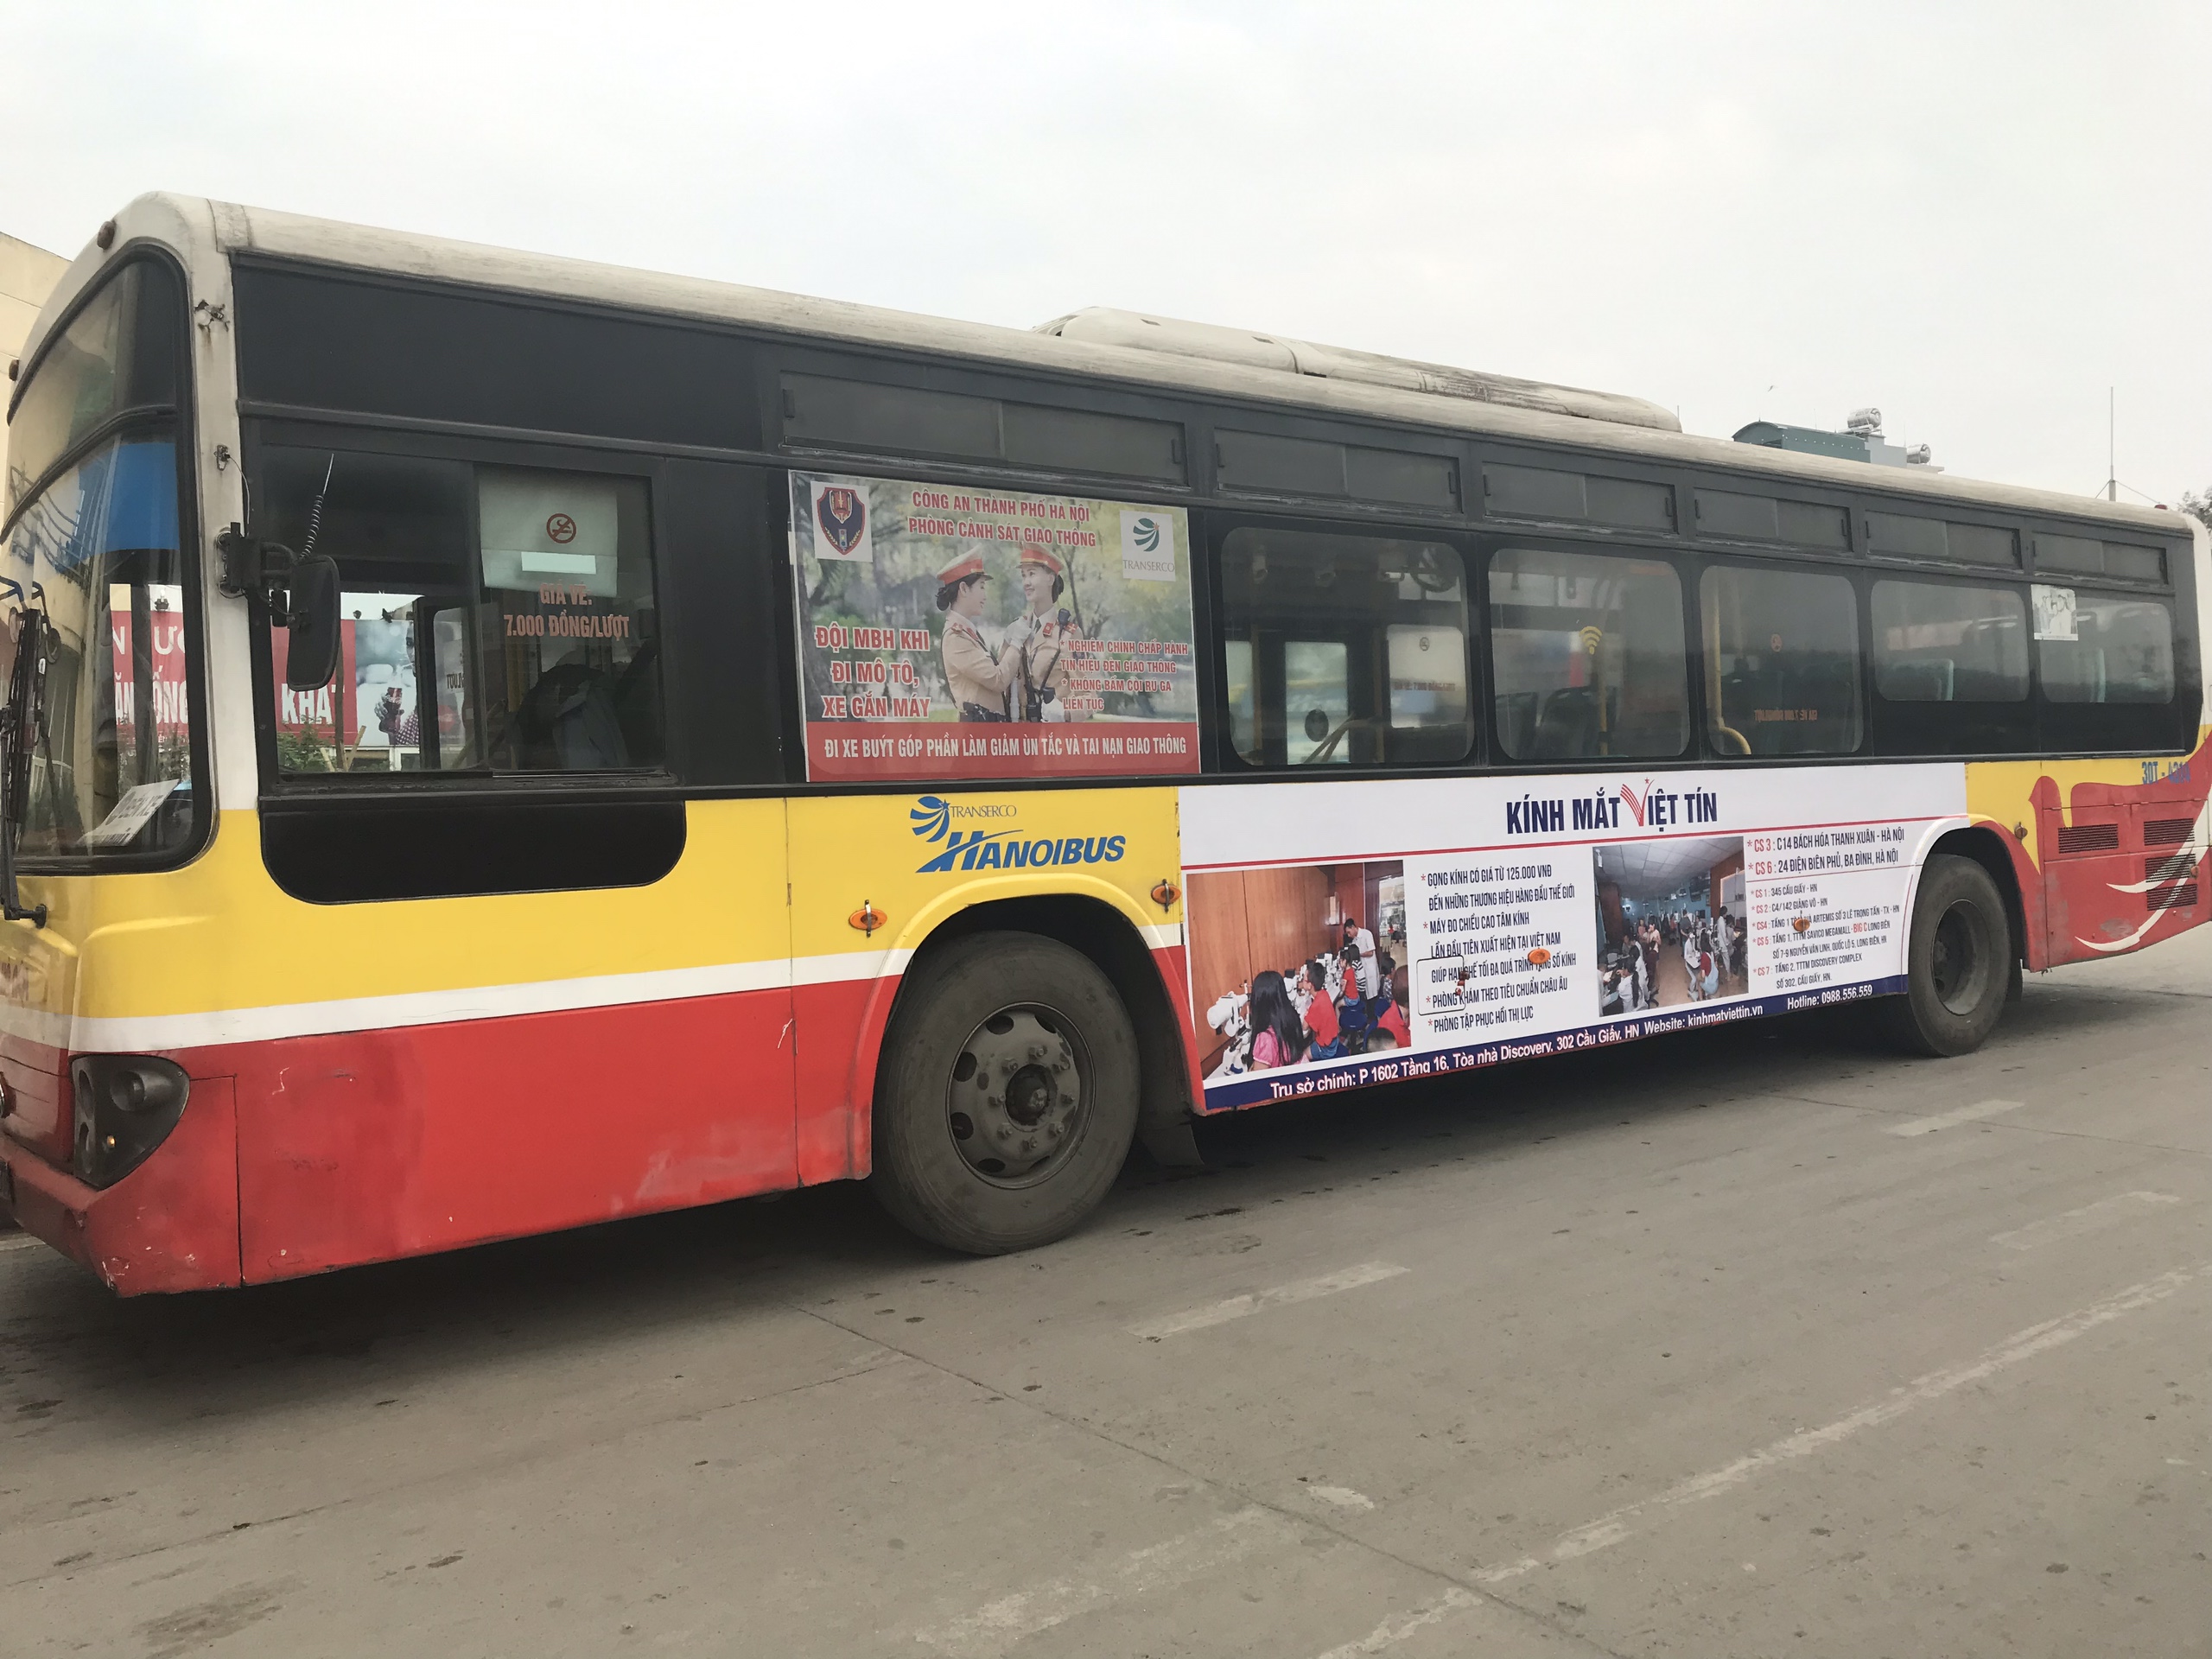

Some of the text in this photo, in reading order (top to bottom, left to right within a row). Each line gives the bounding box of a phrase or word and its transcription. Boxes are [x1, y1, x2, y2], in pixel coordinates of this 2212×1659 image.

[912, 490, 1090, 524] CÔNG AN THÀNH PHỐ HÀ NỘI
[909, 516, 1096, 547] PHÒNG CẢNH SÁT GIAO THÔNG
[1122, 559, 1175, 572] TRANSERCO
[539, 579, 566, 605] GIÁ
[503, 614, 544, 637] 7.000
[815, 622, 930, 652] ĐỘI MBH KHI
[1138, 639, 1161, 654] CHẤP
[1164, 640, 1188, 654] HÀNH
[831, 658, 919, 688] ĐI MÔ TÔ,
[1124, 661, 1145, 672] GIAO
[1147, 658, 1176, 673] THÔNG
[1071, 677, 1102, 690] KHÔNG
[1160, 681, 1172, 691] GA
[823, 690, 931, 717] XE GẮN MÁY
[1085, 698, 1104, 712] TỤC
[823, 732, 1187, 759] ĐI XE BUÝT GÓP PHẦN LÀM GIẢM ÙN TẮC VÀ TAI NẠN GIAO THÔNG
[2141, 761, 2158, 785] 30T
[950, 805, 1017, 818] TRANSERCO
[1506, 779, 1718, 834] KÍNH MẮT VIỆT TÍN
[915, 830, 1126, 873] HANOIBUS
[1754, 839, 1764, 852] CS
[1765, 838, 1771, 851] 3
[1793, 833, 1813, 849] BÁCH
[1815, 831, 1829, 848] HÓA
[1831, 832, 1855, 846] THANH
[1856, 829, 1875, 844] XUÂN
[1881, 827, 1891, 842] HÀ
[1892, 826, 1904, 843] NỘI
[1755, 861, 1765, 875] CS
[1767, 861, 1772, 874] 6
[1778, 860, 1789, 874] 24
[1789, 855, 1807, 874] ĐIỆN
[1808, 855, 1825, 870] BIÊN
[1844, 854, 1854, 867] BA
[1875, 849, 1885, 864] HÀ
[1886, 848, 1898, 865] NỘI
[1427, 865, 1551, 888] GỌNG KÍNH CÓ GIÁ TỪ 125.000 VNĐ
[1429, 893, 1443, 911] ĐẾN
[1498, 889, 1514, 906] HIỆU
[1516, 887, 1533, 903] HÀNG
[1549, 883, 1561, 899] THẾ
[1770, 887, 1782, 897] 345
[1430, 911, 1529, 934] MÁY ĐO CHIỀU CAO TÂM KÍNH
[1813, 912, 1835, 923] ARTEMIS
[1853, 922, 1863, 933] BIG
[1462, 931, 1560, 955] TIÊN XUẤT HIỆN TẠI VIỆT NAM
[1431, 951, 1577, 983] GIÚP TỐI ĐA QUÁ SỐ KÍNH
[1810, 953, 1863, 969] DISCOVERY COMPLEX
[1433, 976, 1568, 1008] PHÒNG KHÁM THEO TIÊU CHUẨN CHÂU ÂU
[1787, 984, 1873, 1010] Hotline: 0988.556.559
[1434, 1016, 1459, 1033] PHÒNG
[1460, 1013, 1473, 1030] TẬP
[1476, 1012, 1494, 1027] PHỤC
[1509, 1008, 1519, 1022] THỊ
[1521, 1006, 1533, 1021] LỰC
[1296, 1077, 1314, 1095] sở
[1318, 1071, 1356, 1091] chính:
[1359, 1068, 1369, 1084] P
[1371, 1064, 1398, 1083] 1602
[1452, 1052, 1474, 1068] Tòa
[1478, 1046, 1498, 1064] nhà
[1556, 1034, 1574, 1051] 302
[1576, 1029, 1596, 1047] Cầu
[1624, 1024, 1640, 1039] HN
[1643, 1017, 1685, 1035] Website:
[1688, 1004, 1764, 1027] kinhmatviettin.vn
